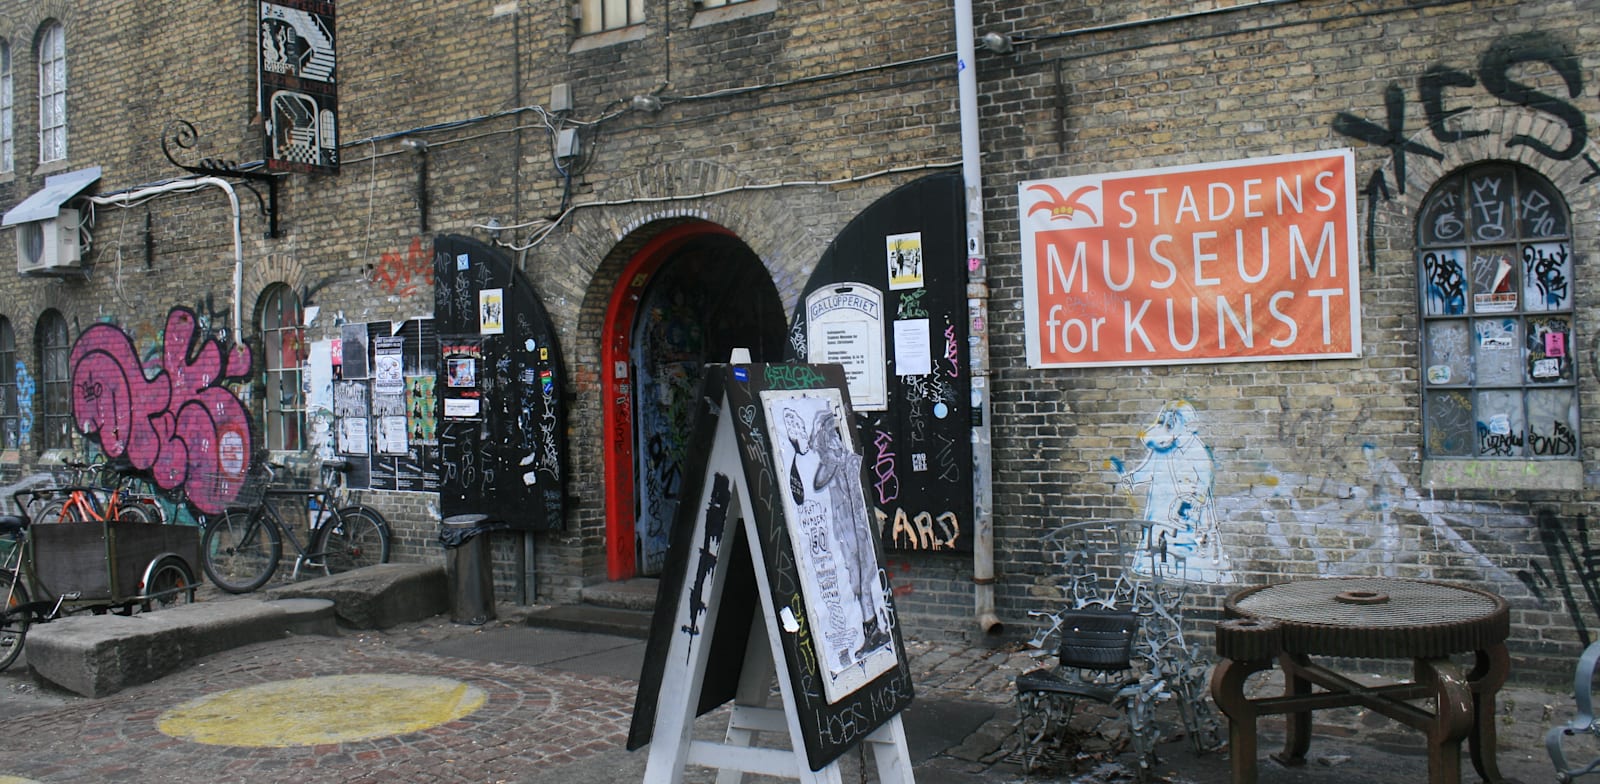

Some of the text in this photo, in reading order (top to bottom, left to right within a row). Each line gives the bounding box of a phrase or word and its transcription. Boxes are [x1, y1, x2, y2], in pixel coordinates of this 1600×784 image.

[1118, 170, 1337, 229] STADENS
[1046, 221, 1338, 296] MUSEUM
[812, 295, 875, 316] GALLOPPERIET
[1046, 303, 1106, 354] for
[1124, 288, 1344, 354] KUNST
